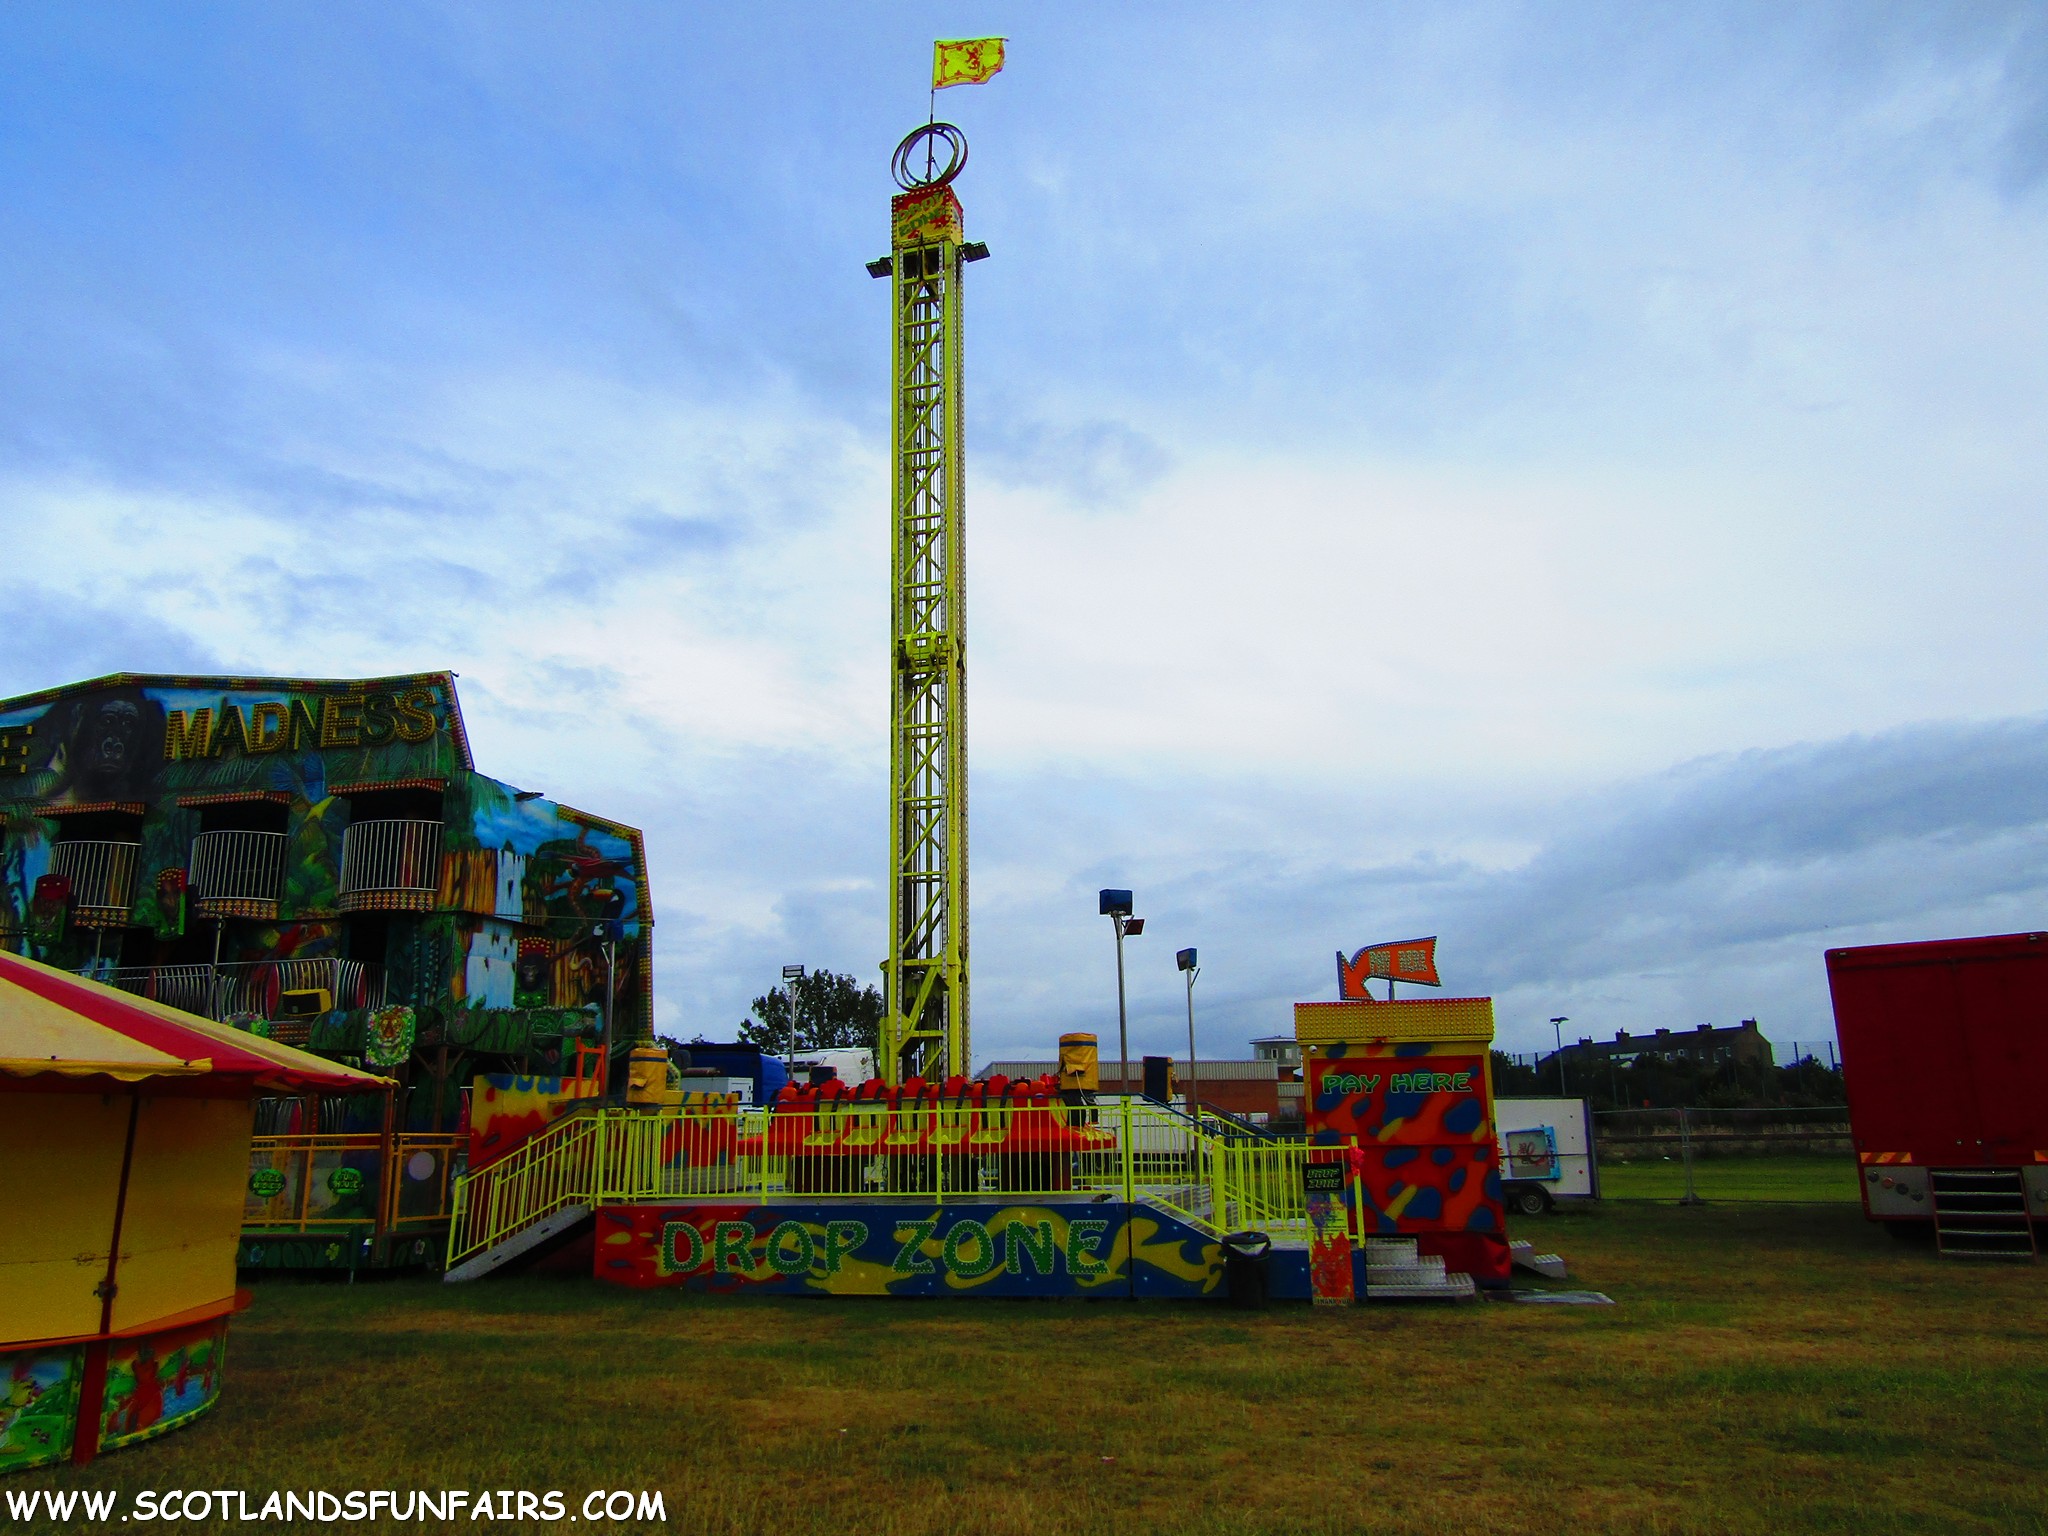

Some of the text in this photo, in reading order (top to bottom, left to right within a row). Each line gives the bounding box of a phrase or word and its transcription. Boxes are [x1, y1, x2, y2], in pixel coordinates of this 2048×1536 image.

[163, 689, 437, 760] MADNESS
[1322, 1073, 1473, 1095] PAY HERE
[661, 1219, 1110, 1276] DROP ZONE
